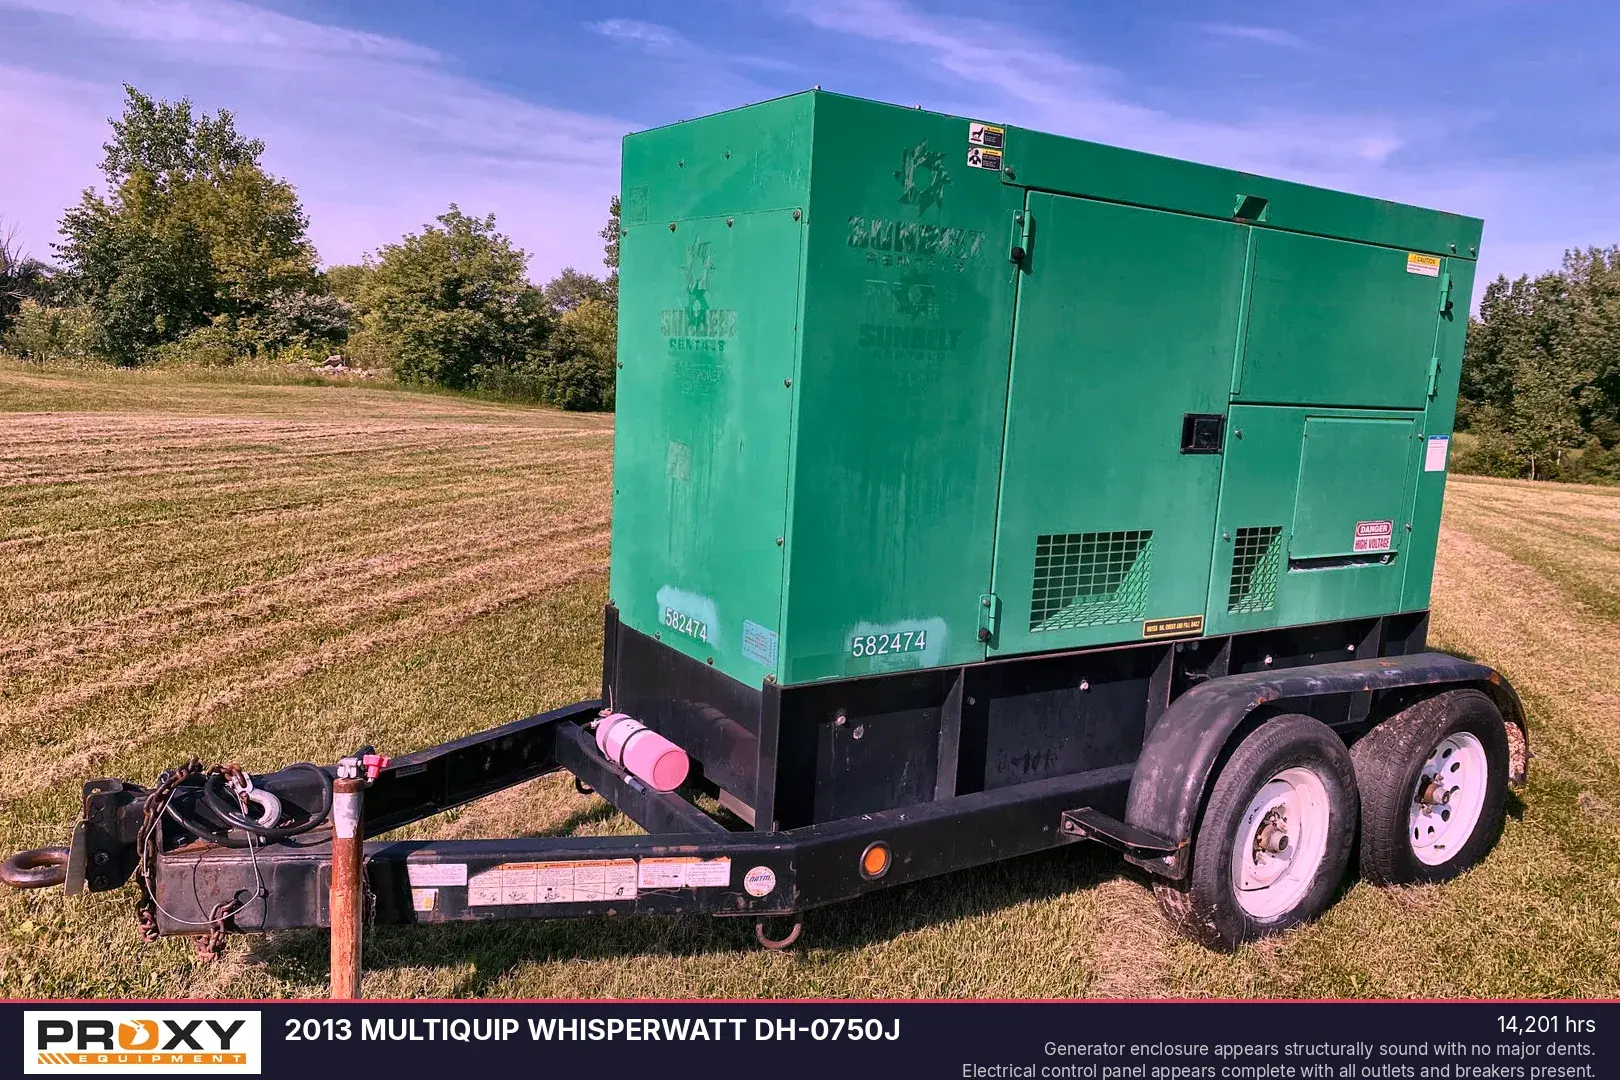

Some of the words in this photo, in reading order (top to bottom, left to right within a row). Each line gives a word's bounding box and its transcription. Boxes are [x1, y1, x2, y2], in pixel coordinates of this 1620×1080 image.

[1359, 524, 1389, 534] DANGER
[1355, 539, 1368, 549] HIGH
[1369, 537, 1390, 549] VOLTAGE
[665, 607, 707, 643] 582474
[852, 630, 926, 657] 582474
